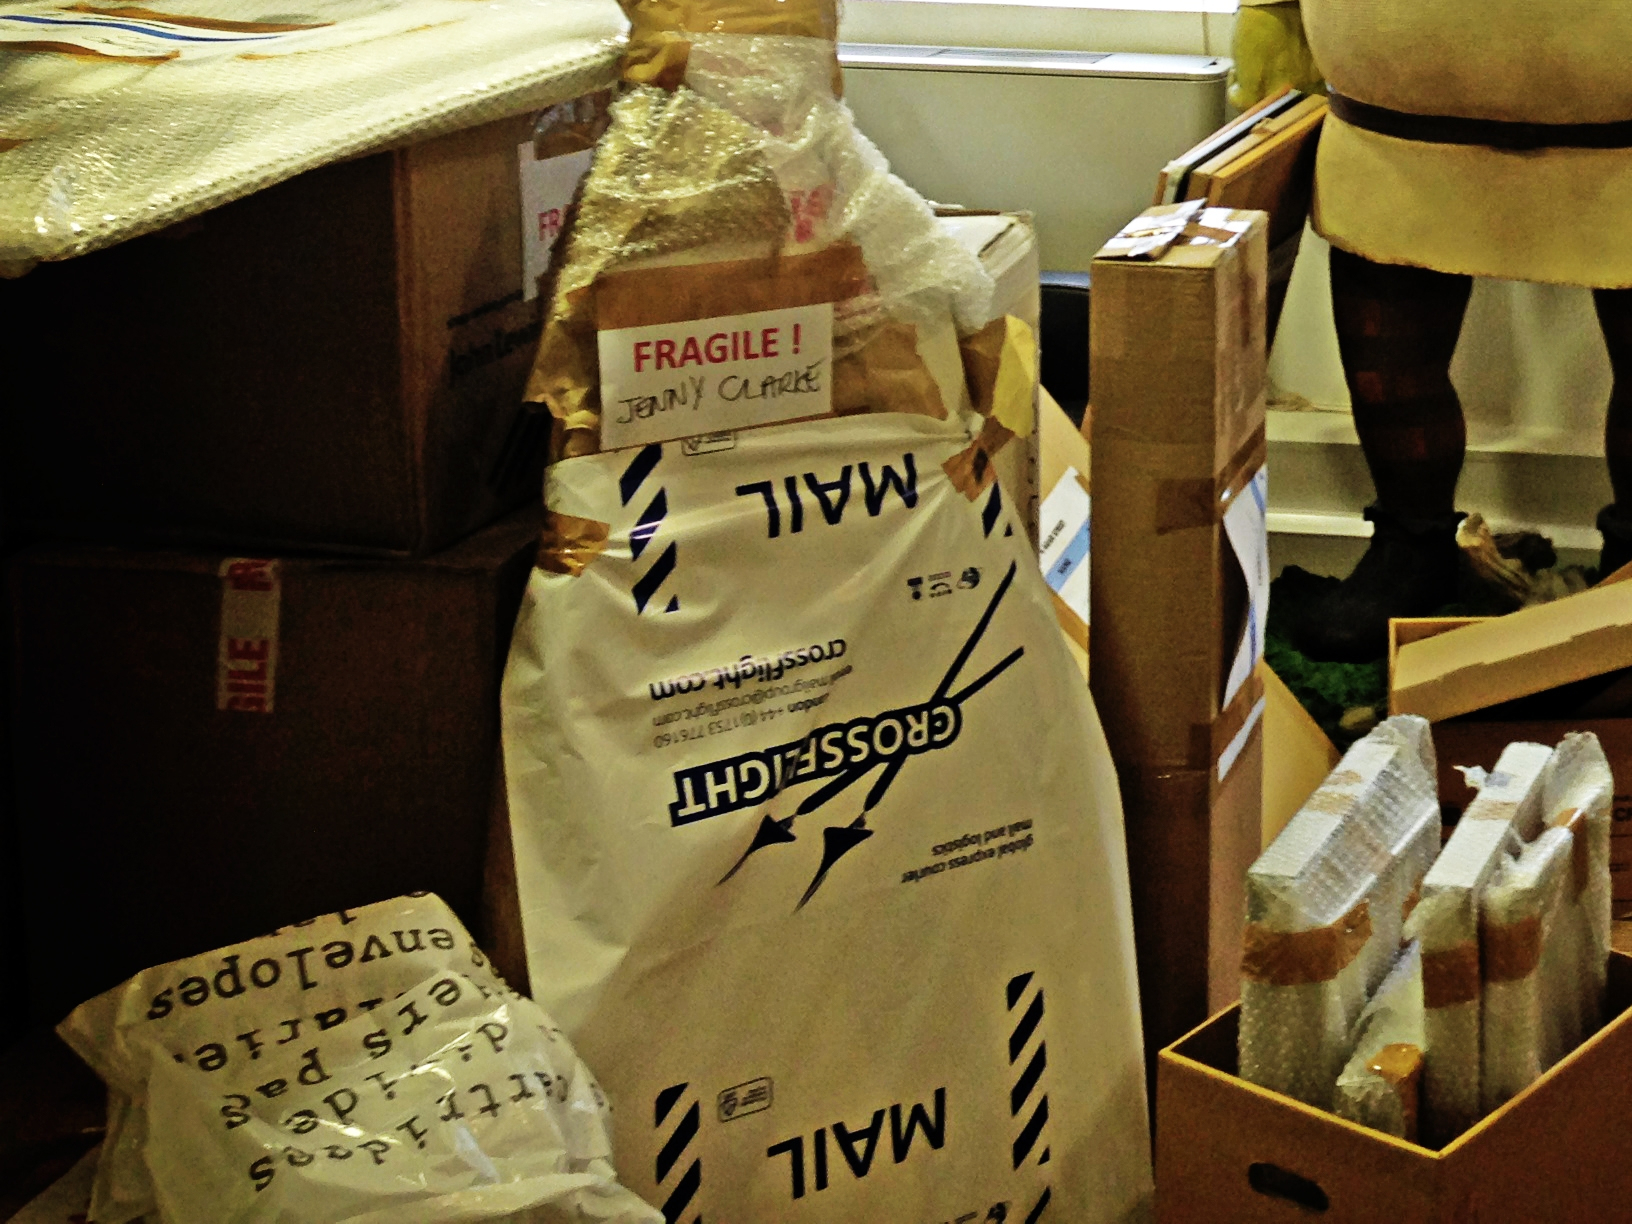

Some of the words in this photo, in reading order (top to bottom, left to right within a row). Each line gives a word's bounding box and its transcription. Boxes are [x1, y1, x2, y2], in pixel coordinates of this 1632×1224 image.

[616, 376, 705, 424] JENNY
[718, 357, 827, 402] CLARKE
[633, 327, 780, 373] FRAGILE
[735, 452, 919, 539] MAIL
[649, 639, 847, 700] crossflight.com
[676, 703, 957, 817] CROSSFLIGHT
[146, 927, 455, 1021] envelopes
[767, 1086, 946, 1200] MAIL
